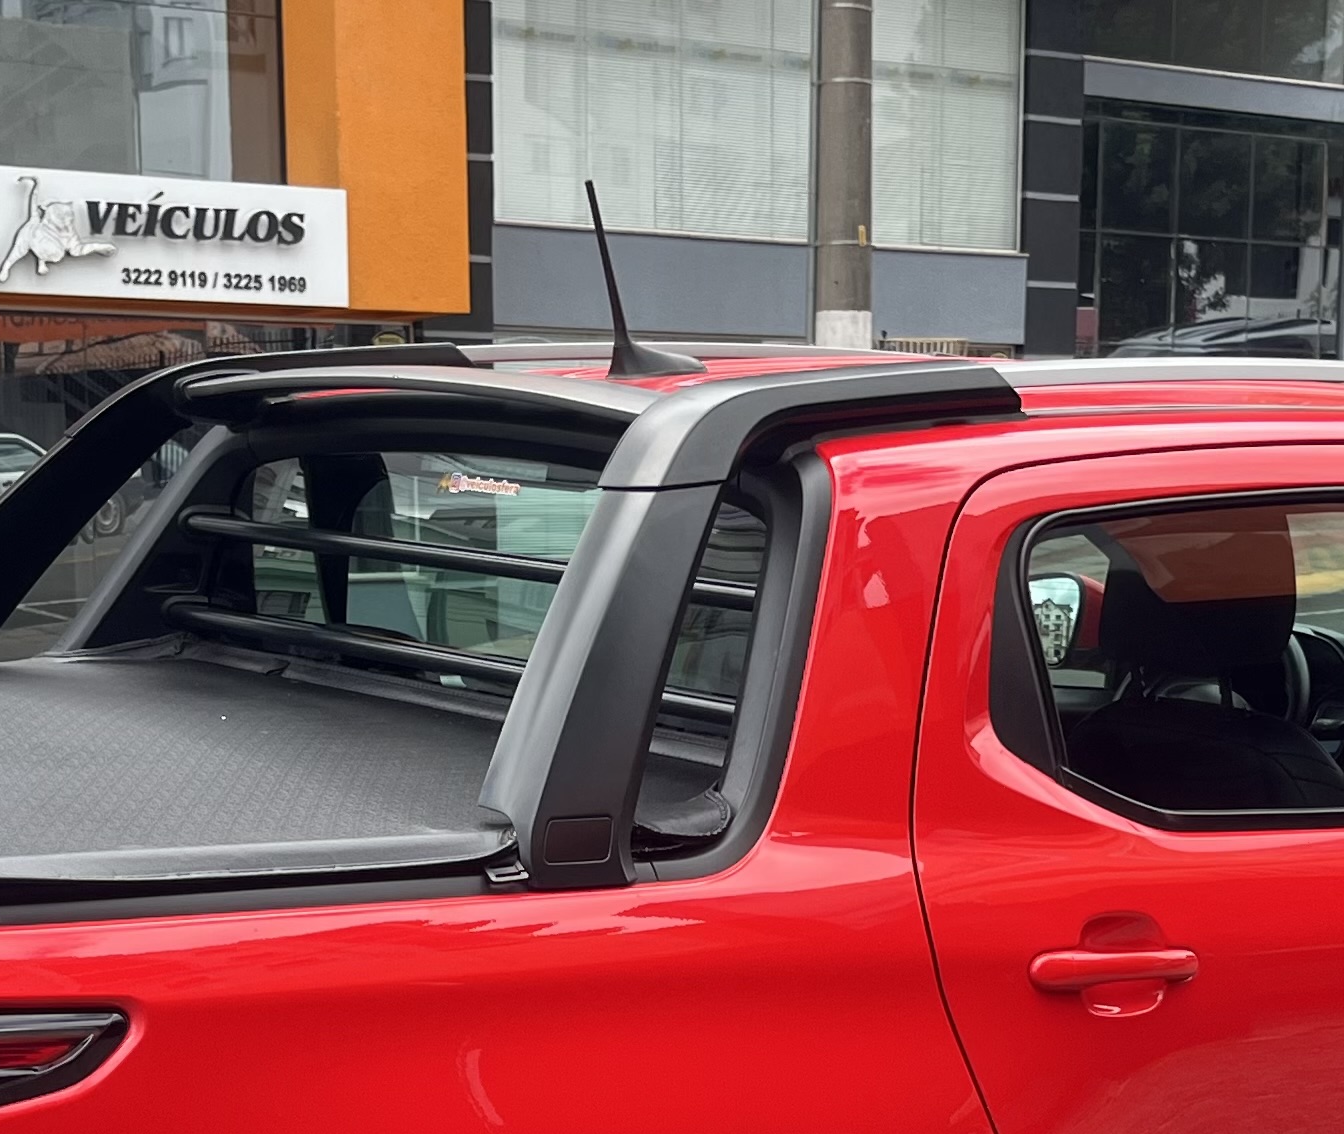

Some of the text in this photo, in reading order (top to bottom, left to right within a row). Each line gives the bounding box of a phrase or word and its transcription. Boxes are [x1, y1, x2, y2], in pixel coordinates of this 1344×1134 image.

[85, 191, 306, 246] VEÍCULOS
[121, 267, 163, 286] 3222
[169, 270, 207, 288] 9119
[223, 273, 263, 291] 3225
[268, 275, 307, 293] 1969
